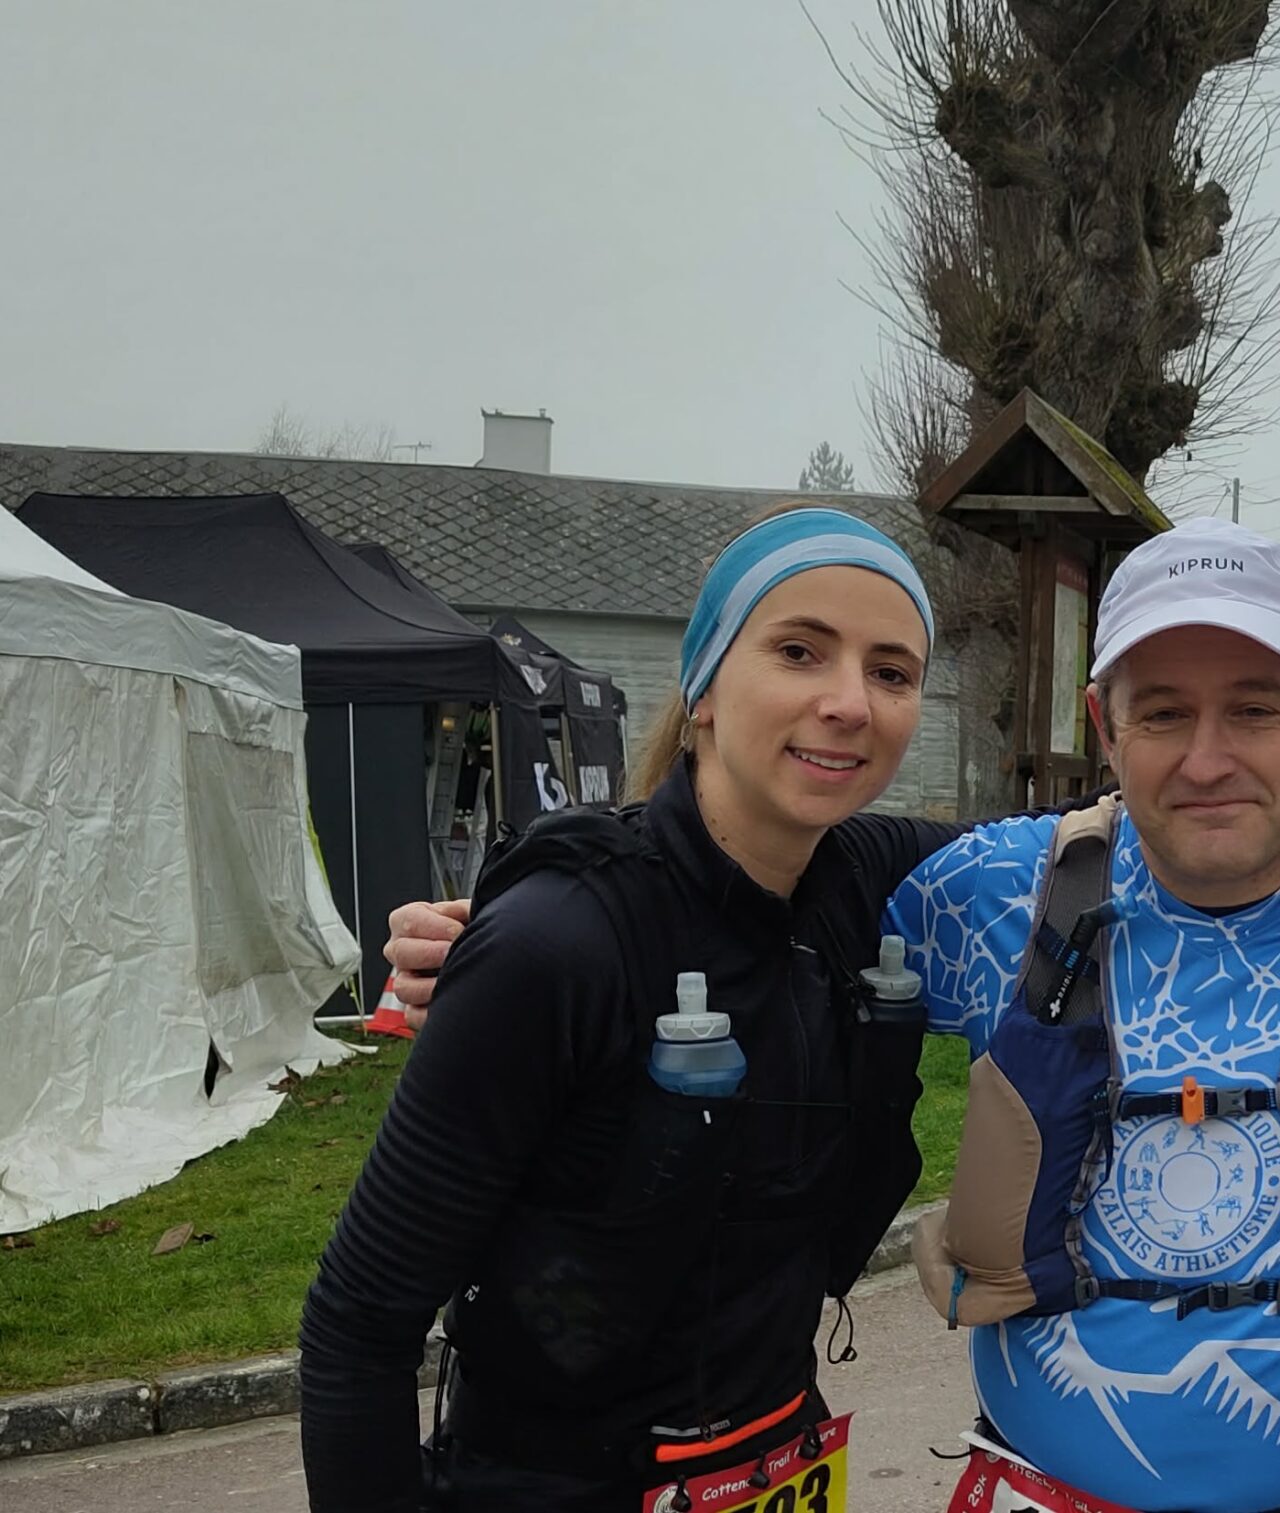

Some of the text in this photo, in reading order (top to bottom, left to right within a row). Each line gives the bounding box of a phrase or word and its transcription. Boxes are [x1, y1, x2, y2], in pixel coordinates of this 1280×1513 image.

[1168, 557, 1244, 579] KIPRUN
[1097, 1187, 1153, 1261] CALAIS
[1154, 1193, 1278, 1273] ATHLETISME
[768, 1453, 791, 1474] Trail
[968, 1474, 987, 1507] 29k
